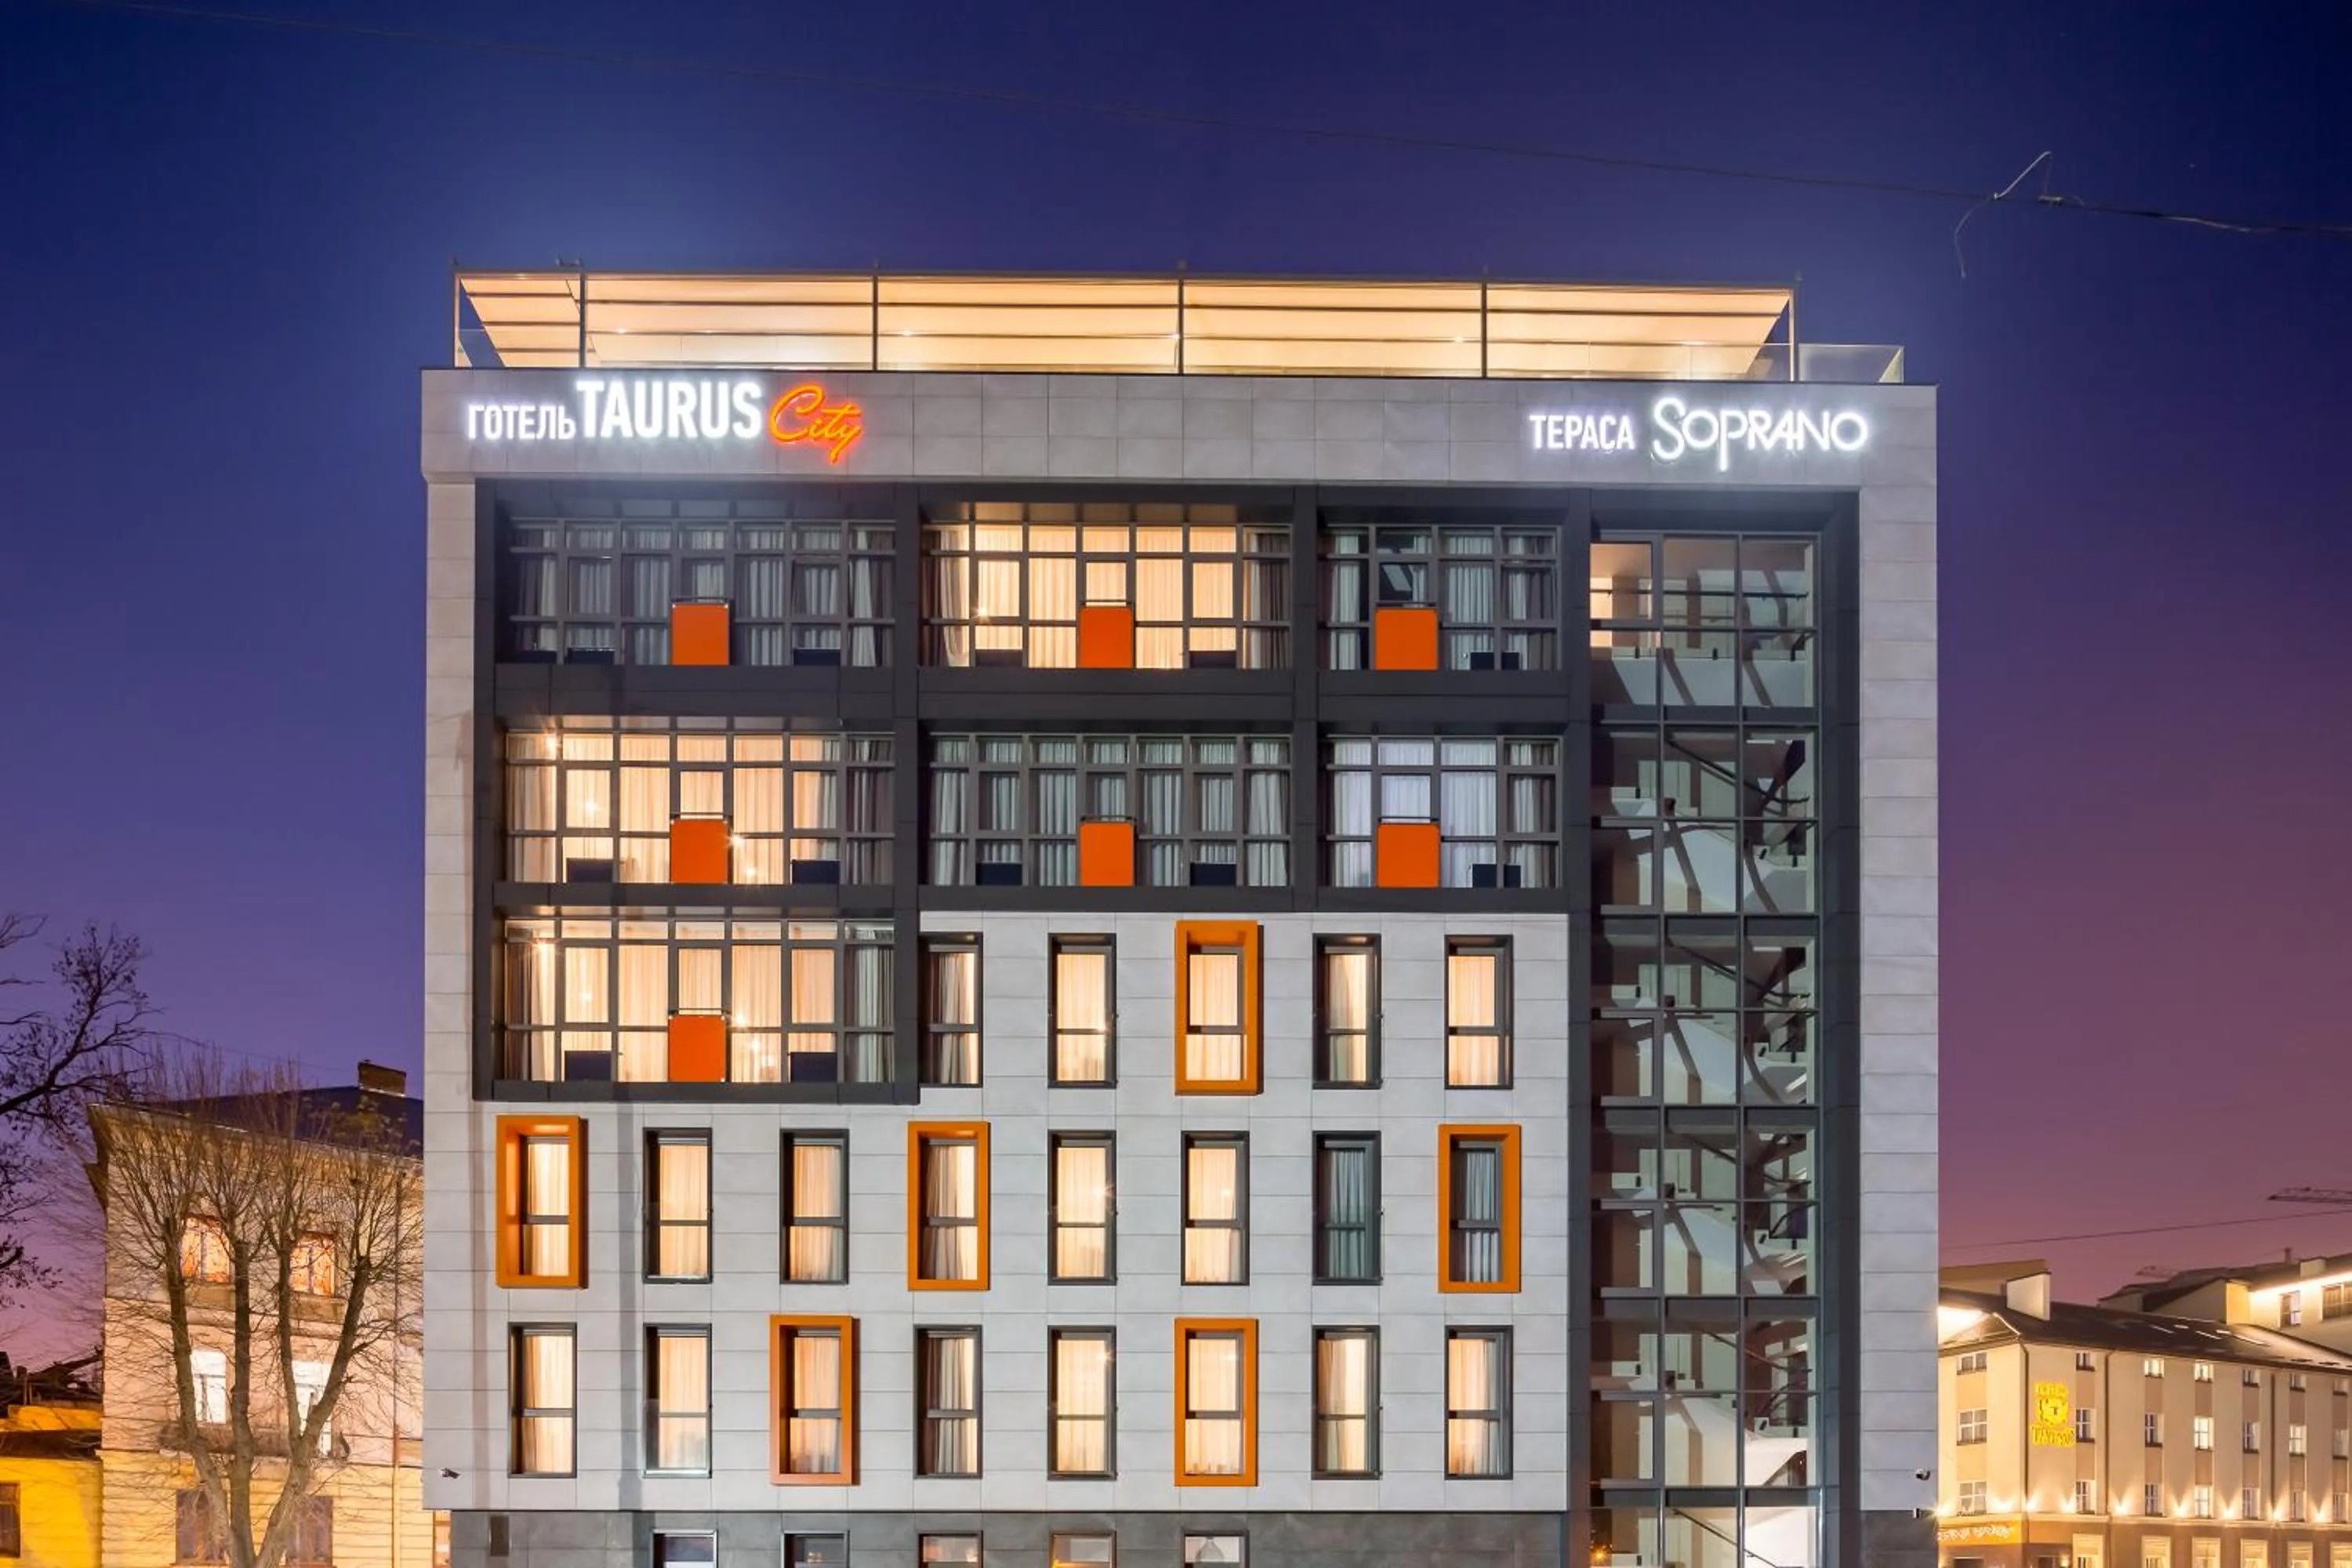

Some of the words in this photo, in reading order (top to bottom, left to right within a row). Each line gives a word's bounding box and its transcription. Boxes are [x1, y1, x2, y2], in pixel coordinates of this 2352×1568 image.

[467, 404, 576, 440] ГОТЕЛЬ
[575, 380, 764, 438] TAURUS
[769, 383, 862, 464] City
[1530, 415, 1635, 450] ТЕРАСА
[1653, 397, 1869, 470] SOPRANO
